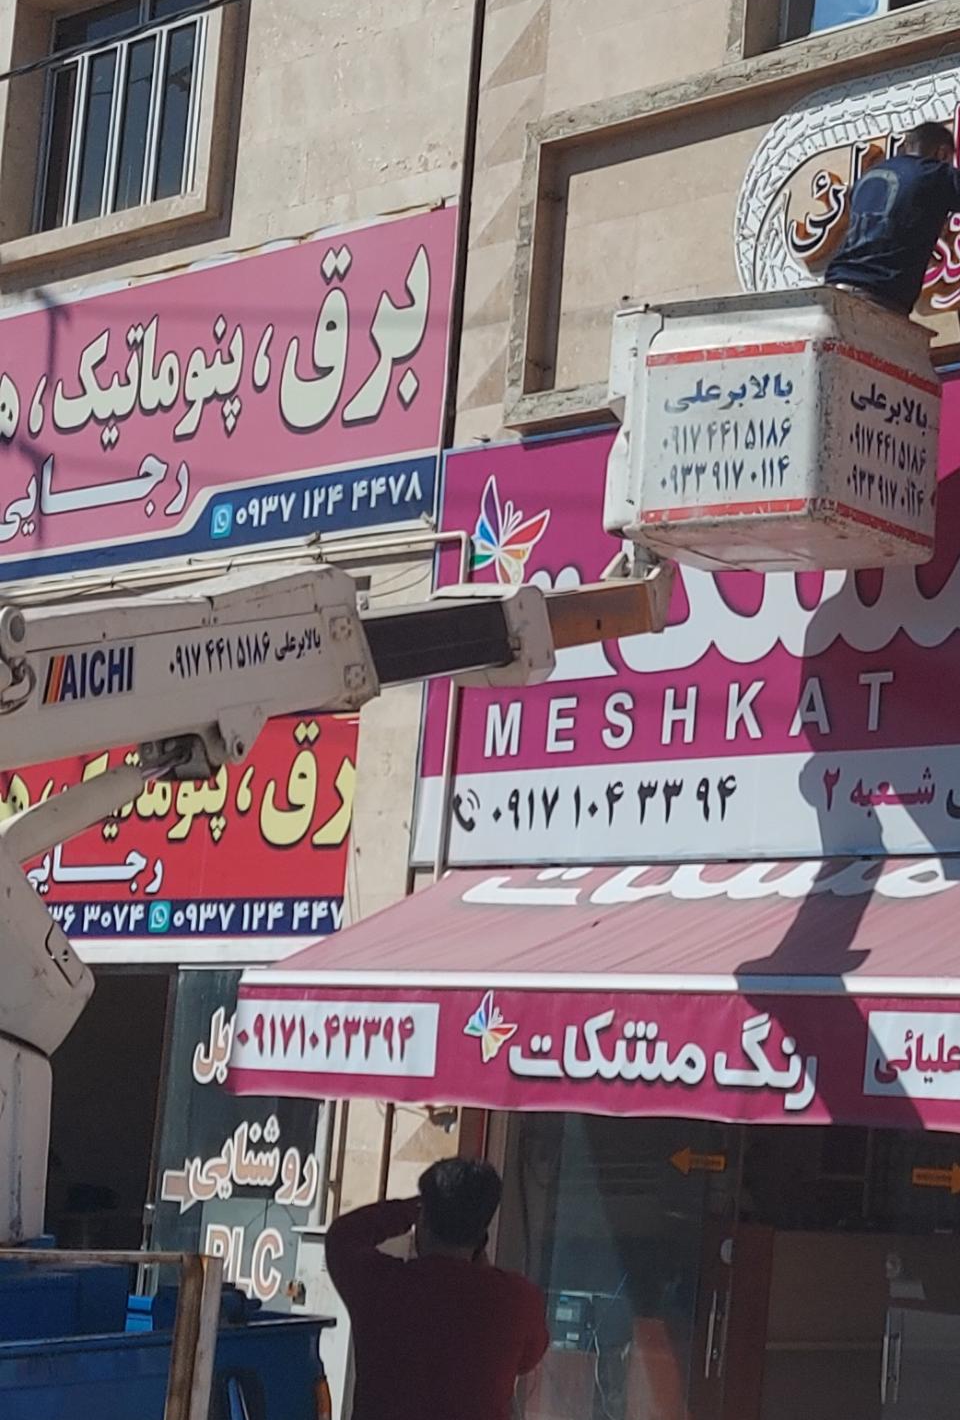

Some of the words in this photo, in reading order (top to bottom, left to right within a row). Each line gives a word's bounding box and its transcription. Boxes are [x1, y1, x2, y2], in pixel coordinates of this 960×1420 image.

[235, 489, 296, 528] ۰۹۳۷
[301, 483, 344, 520] ۱۲۴
[350, 469, 423, 513] ۴۴۷۸
[60, 646, 136, 702] AICHI
[484, 672, 894, 758] MESHKAT
[492, 784, 560, 831] ۰۹۱۷
[573, 780, 625, 829] ۱۰۴
[636, 776, 684, 826] ۳۳
[696, 773, 737, 823] ۹۴
[822, 767, 841, 812] ۲
[850, 766, 936, 819] شعبه
[173, 901, 236, 932] ۰۹۳۷
[242, 900, 285, 932] ۱۲۴
[236, 1012, 416, 1063] ۰۹۱۷۱۰۴۳۳۹۴
[508, 1008, 707, 1084] مشکات
[712, 1012, 817, 1111] رنگ
